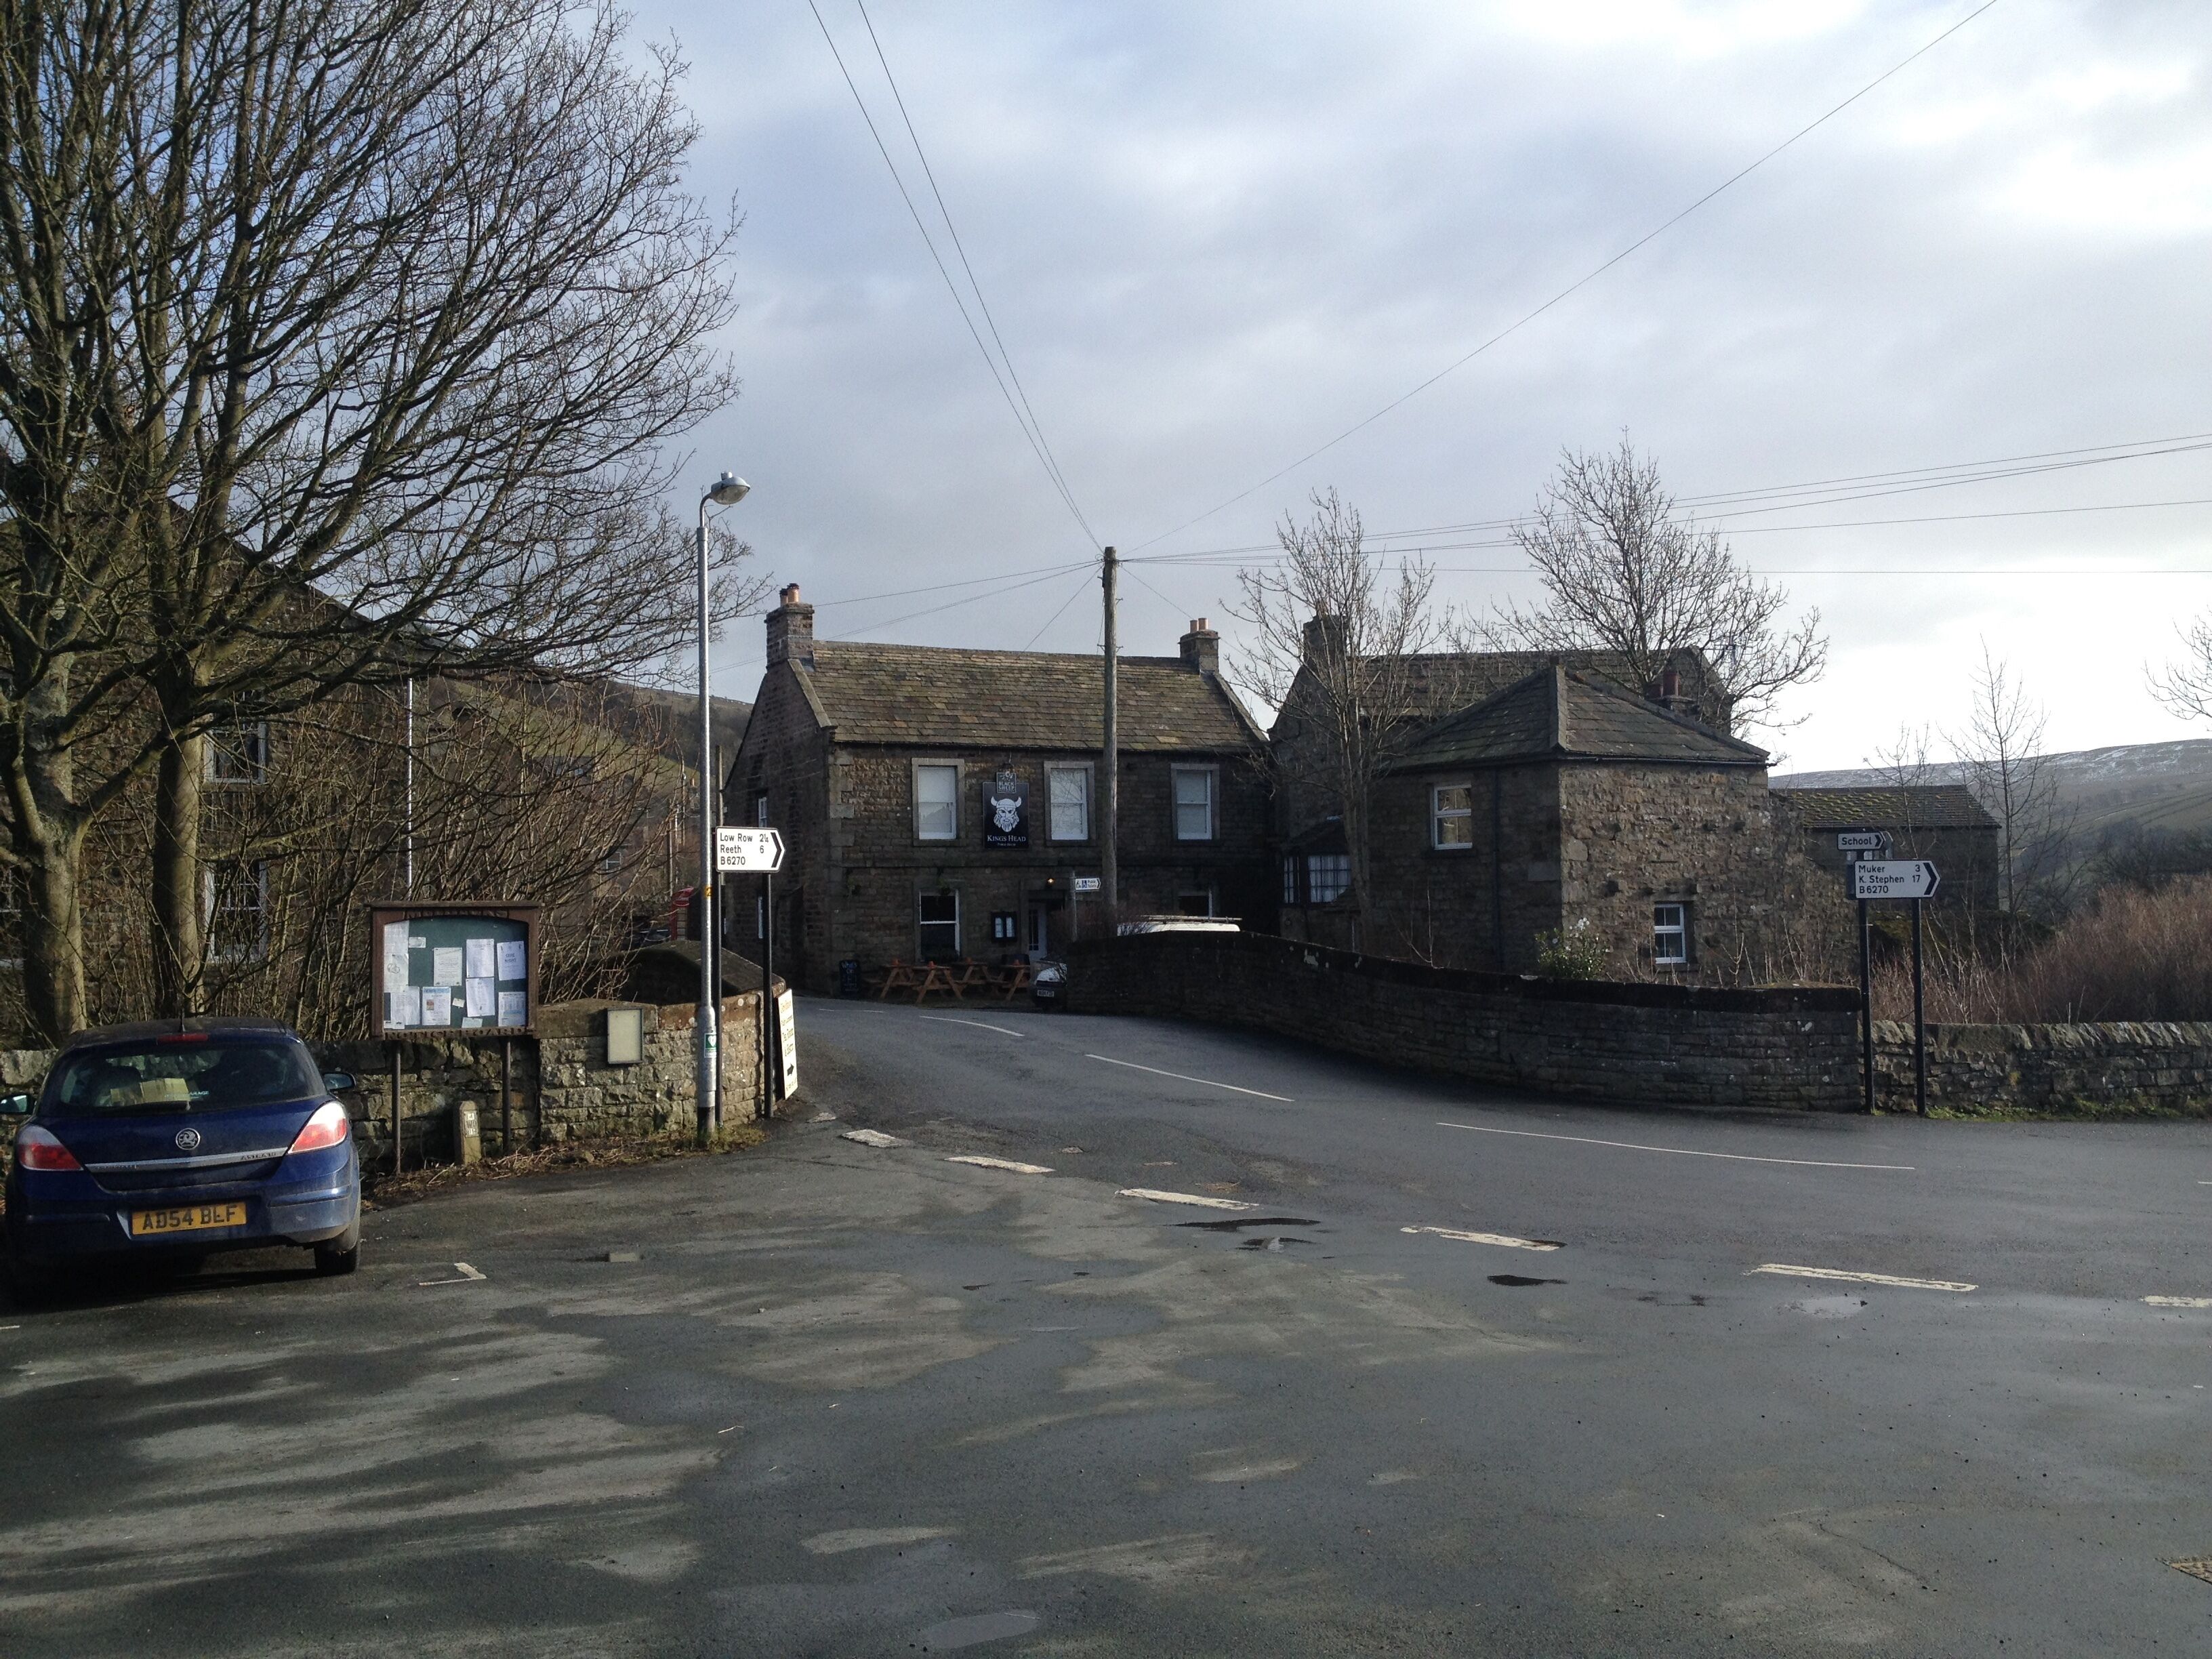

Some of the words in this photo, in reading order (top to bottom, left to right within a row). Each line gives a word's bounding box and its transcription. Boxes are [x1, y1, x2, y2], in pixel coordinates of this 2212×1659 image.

[720, 832, 735, 842] Low
[737, 833, 753, 842] Row
[1841, 836, 1872, 846] School
[720, 844, 741, 853] Reeth
[760, 845, 764, 854] 6
[1858, 865, 1885, 873] Muker
[1914, 864, 1921, 872] 3
[1869, 875, 1904, 884] Stephen
[142, 1208, 194, 1231] AD54
